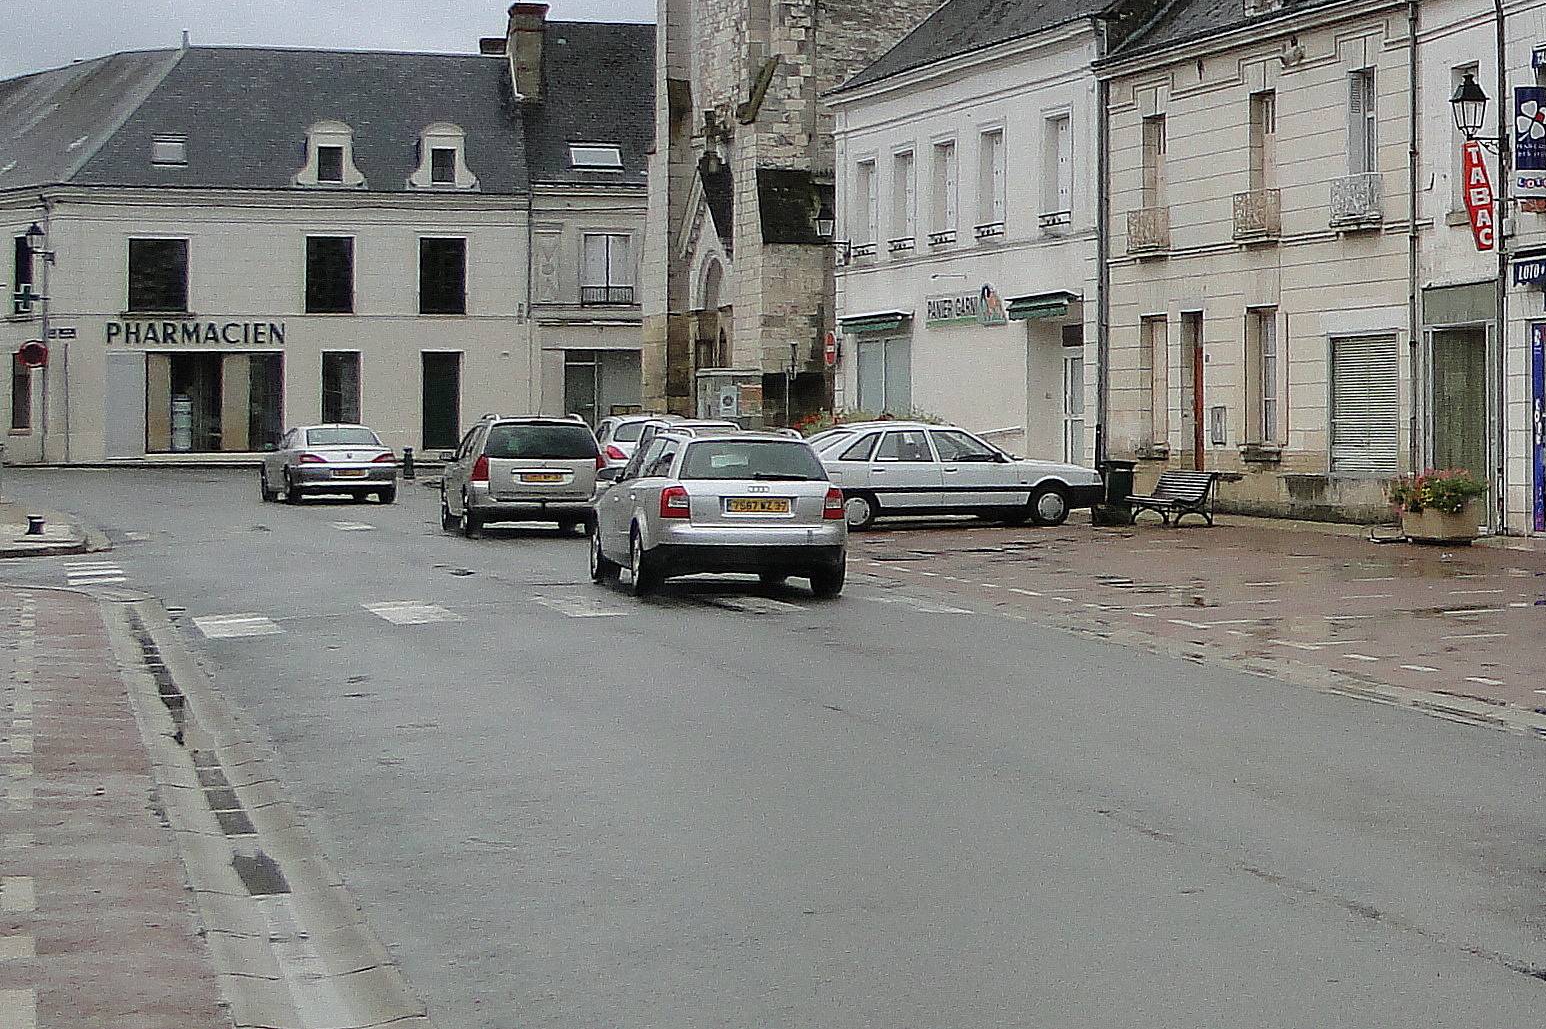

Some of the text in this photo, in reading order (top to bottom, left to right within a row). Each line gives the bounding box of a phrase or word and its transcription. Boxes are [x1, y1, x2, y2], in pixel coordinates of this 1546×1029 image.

[1467, 146, 1492, 246] TABAC
[1518, 263, 1540, 281] LOTO
[106, 322, 286, 344] PHARMACIEN
